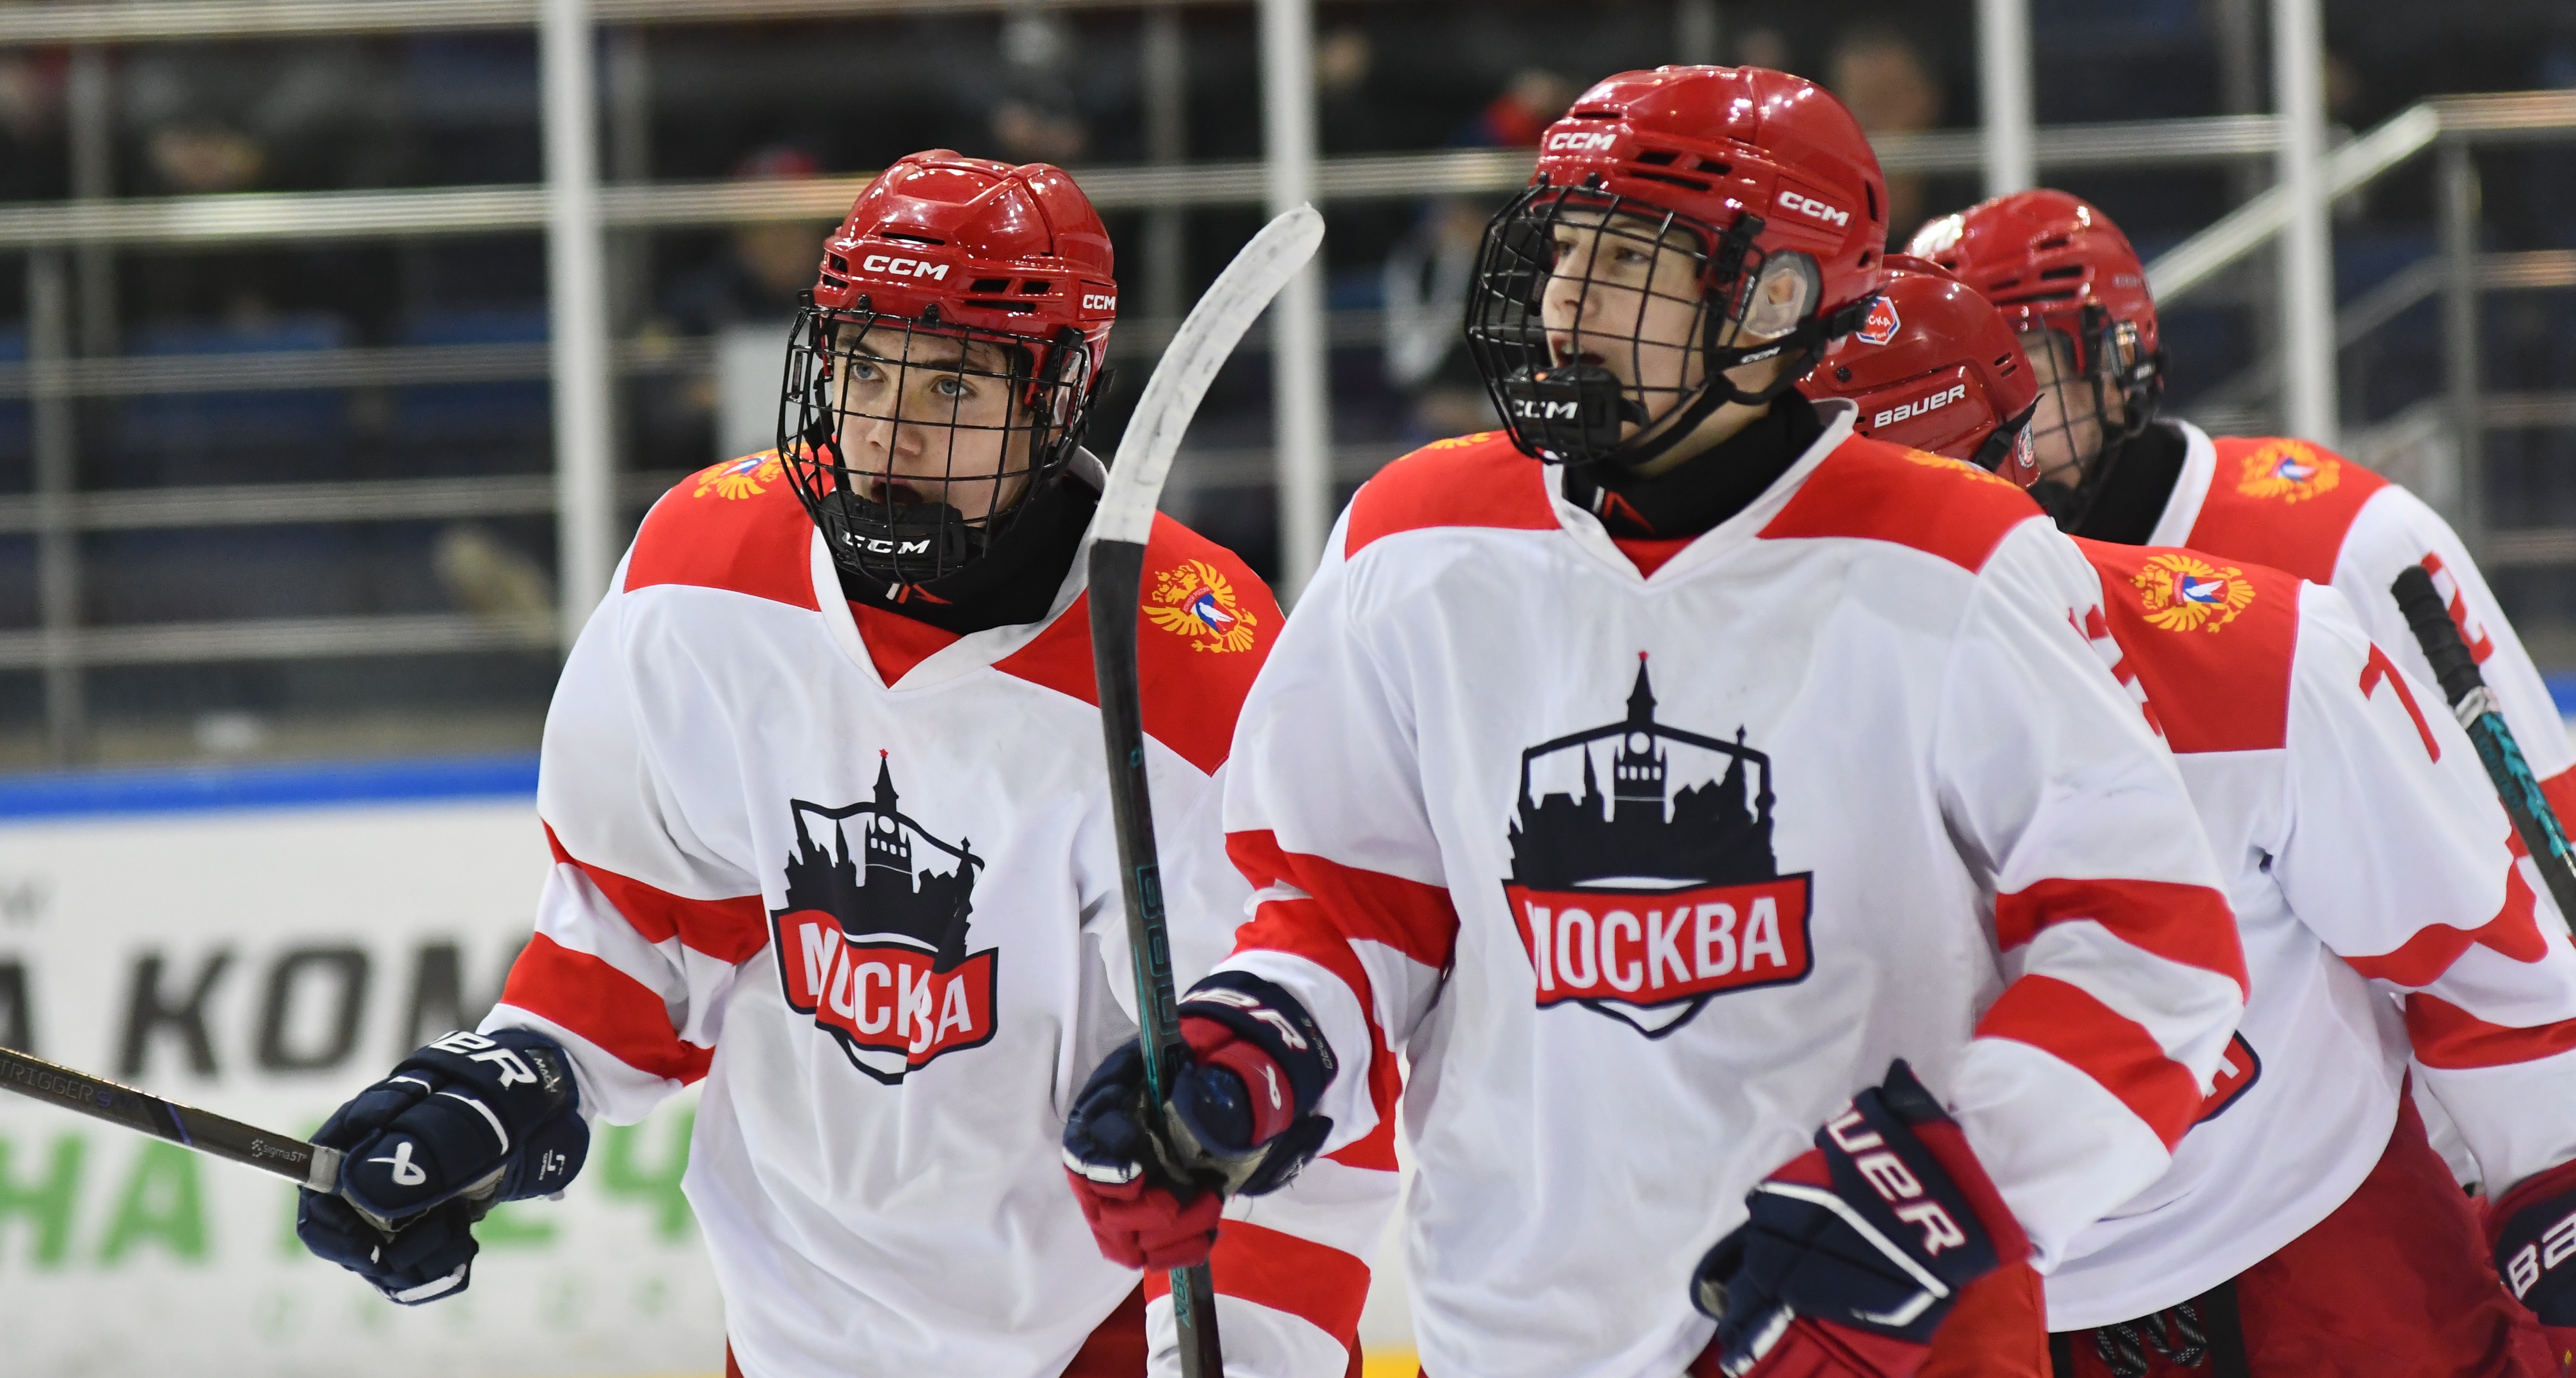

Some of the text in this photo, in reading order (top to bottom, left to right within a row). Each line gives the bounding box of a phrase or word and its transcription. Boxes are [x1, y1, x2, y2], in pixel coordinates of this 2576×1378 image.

[1548, 132, 1617, 151] CCM
[1779, 191, 1850, 226] CCM
[862, 254, 950, 281] CCM
[1082, 294, 1116, 311] CCM
[1866, 315, 1891, 328] СКА
[1874, 383, 1965, 428] BAUER
[841, 529, 931, 554] CCM
[1524, 896, 1788, 993] МОСКВА
[1825, 1101, 1966, 1256] UER
